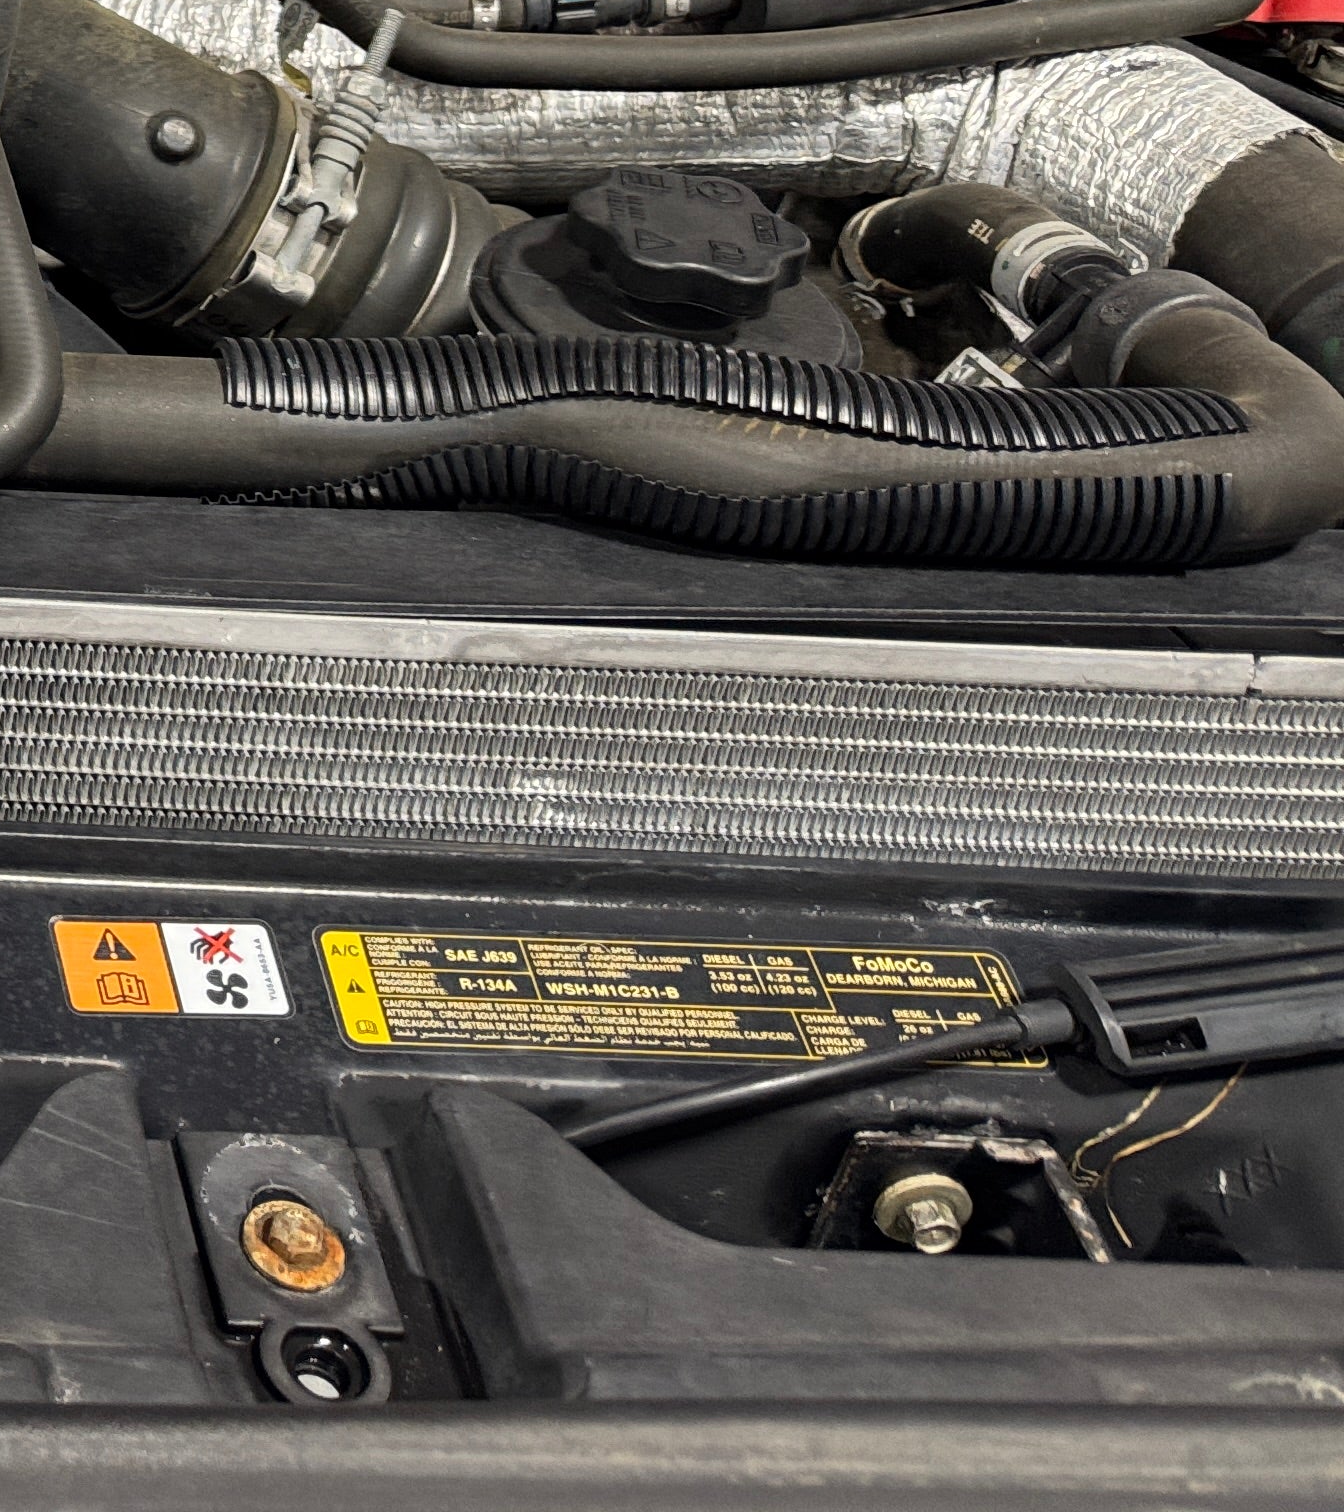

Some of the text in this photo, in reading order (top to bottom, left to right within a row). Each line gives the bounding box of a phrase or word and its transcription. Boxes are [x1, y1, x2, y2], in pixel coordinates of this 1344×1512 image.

[328, 943, 360, 956] A/C
[443, 949, 518, 964] SAE J639
[701, 954, 794, 966] DIESEL GAS
[851, 956, 936, 973] FoMoCo
[707, 971, 810, 983] 3.53 oz 4.23 oz
[825, 973, 979, 989] DEARBORN, MICHIGAN
[458, 977, 518, 992] R-134A
[546, 982, 680, 999] WSH-M1C231-B
[709, 983, 819, 997] (100 cc) (120 cc)
[799, 1014, 886, 1025] CHARGE LEVEL:
[891, 1009, 982, 1021] DIESEL GAS
[804, 1025, 856, 1035] CHARGE:
[918, 1026, 934, 1034] oz
[809, 1036, 867, 1047] CARGA DE
